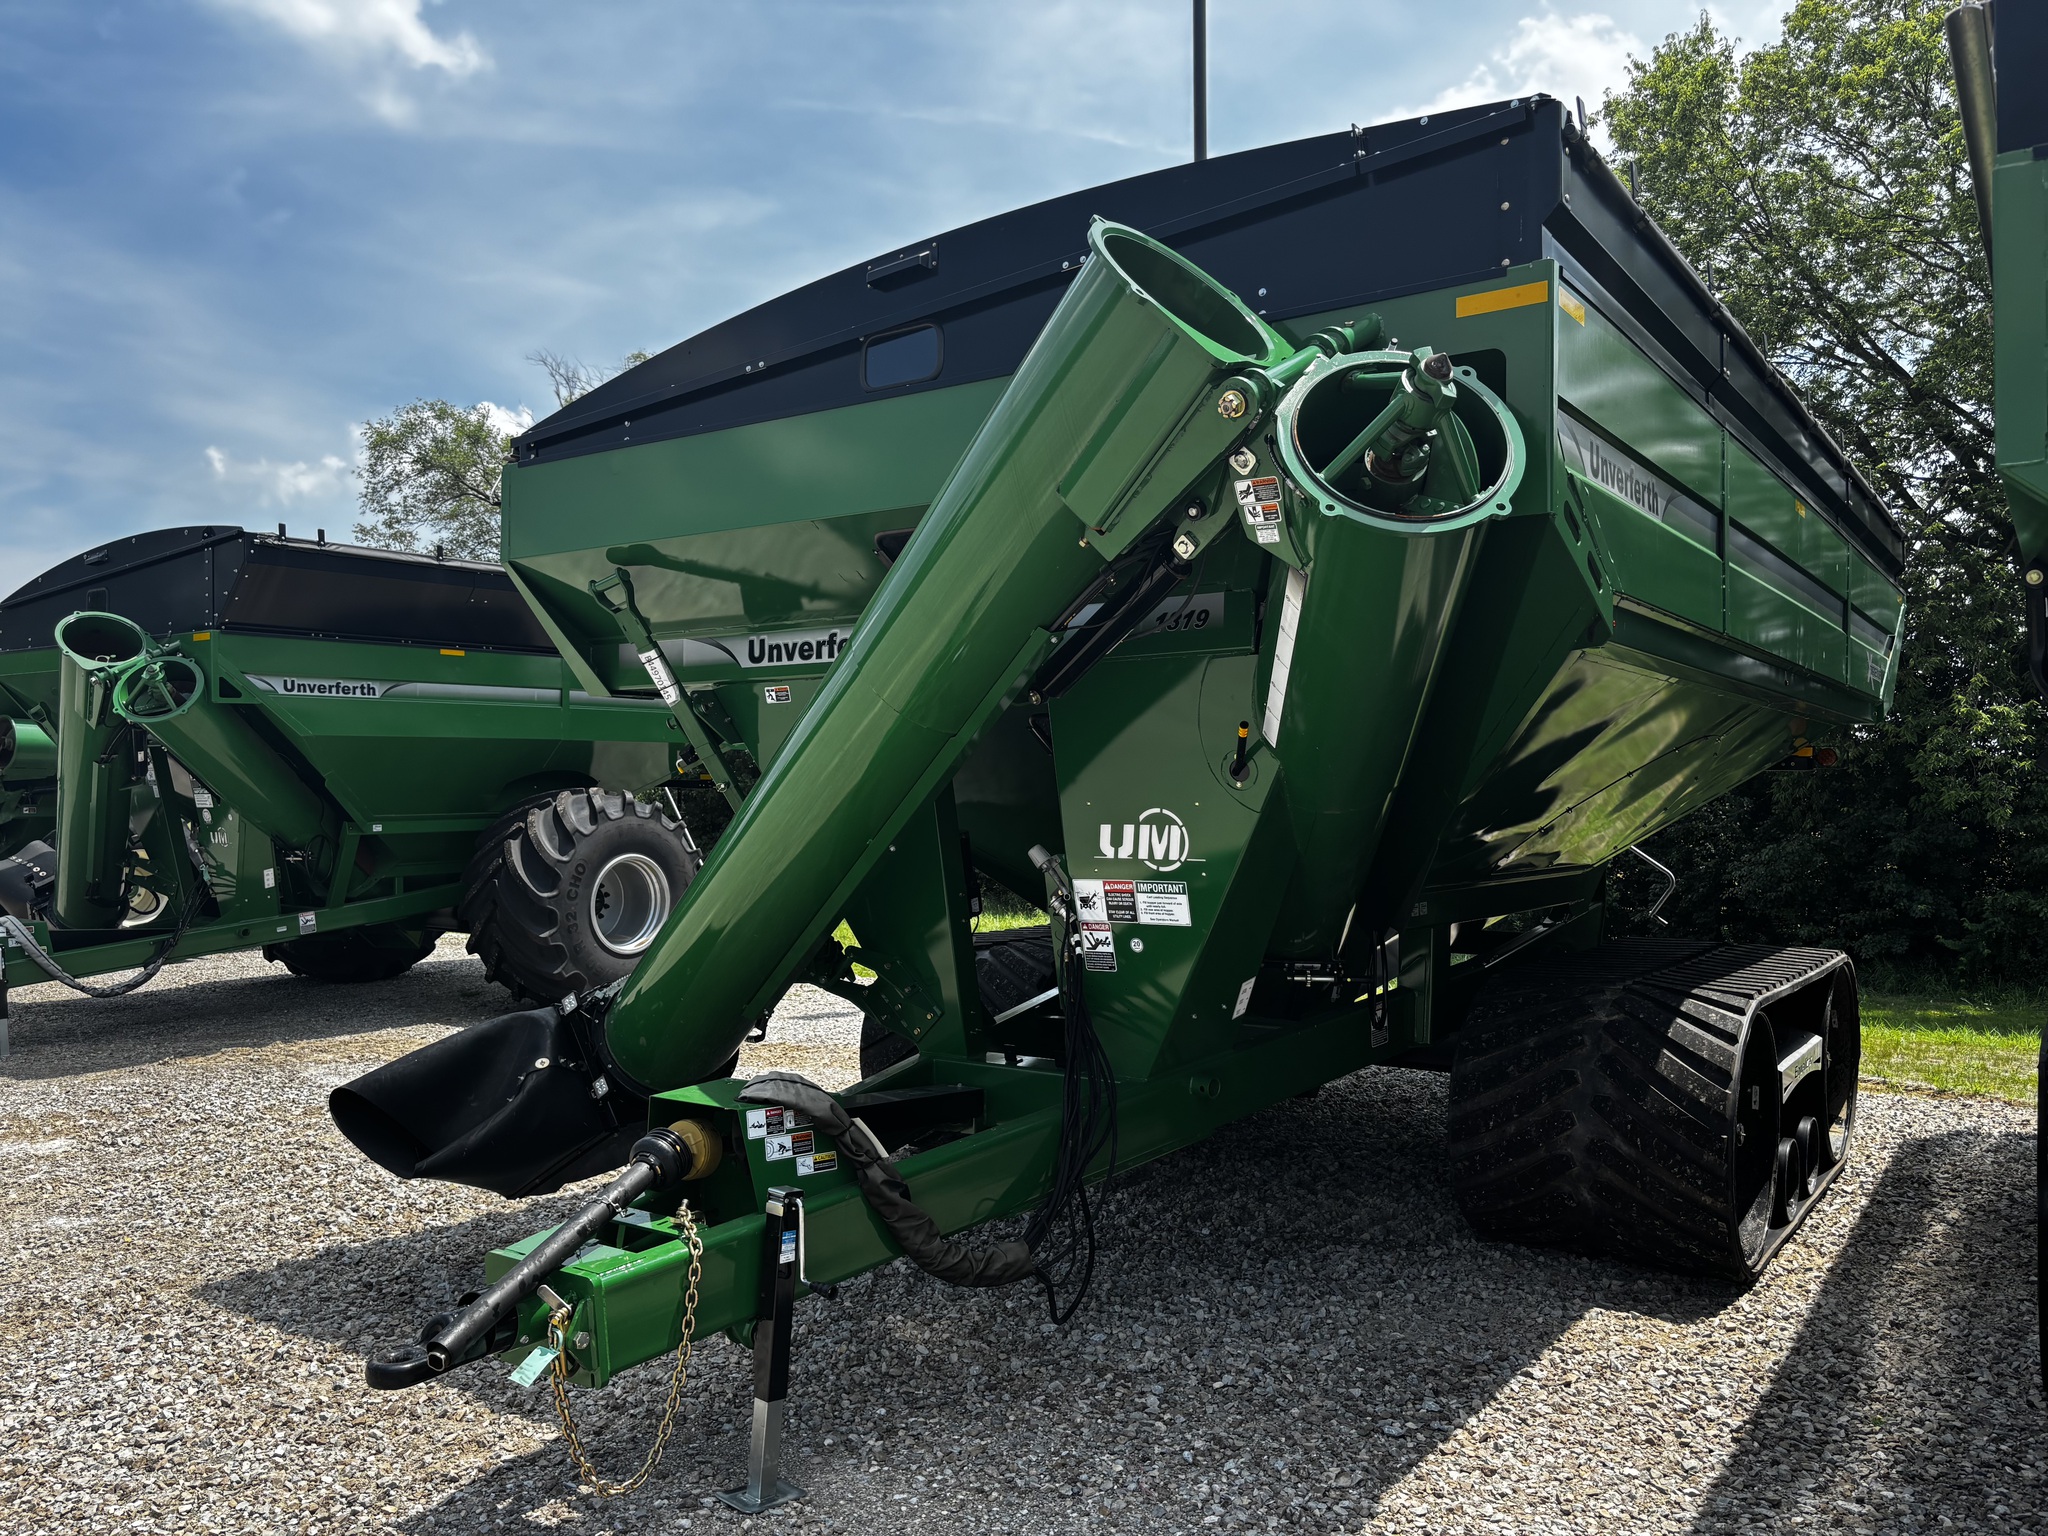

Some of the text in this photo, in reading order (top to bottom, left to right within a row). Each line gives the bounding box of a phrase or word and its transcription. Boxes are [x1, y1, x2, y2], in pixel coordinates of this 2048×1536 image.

[1590, 440, 1659, 516] Unverferth
[283, 679, 377, 696] Unverferth
[566, 861, 587, 902] CHO
[1110, 882, 1133, 890] DANGER
[1137, 883, 1183, 893] IMPORTANT
